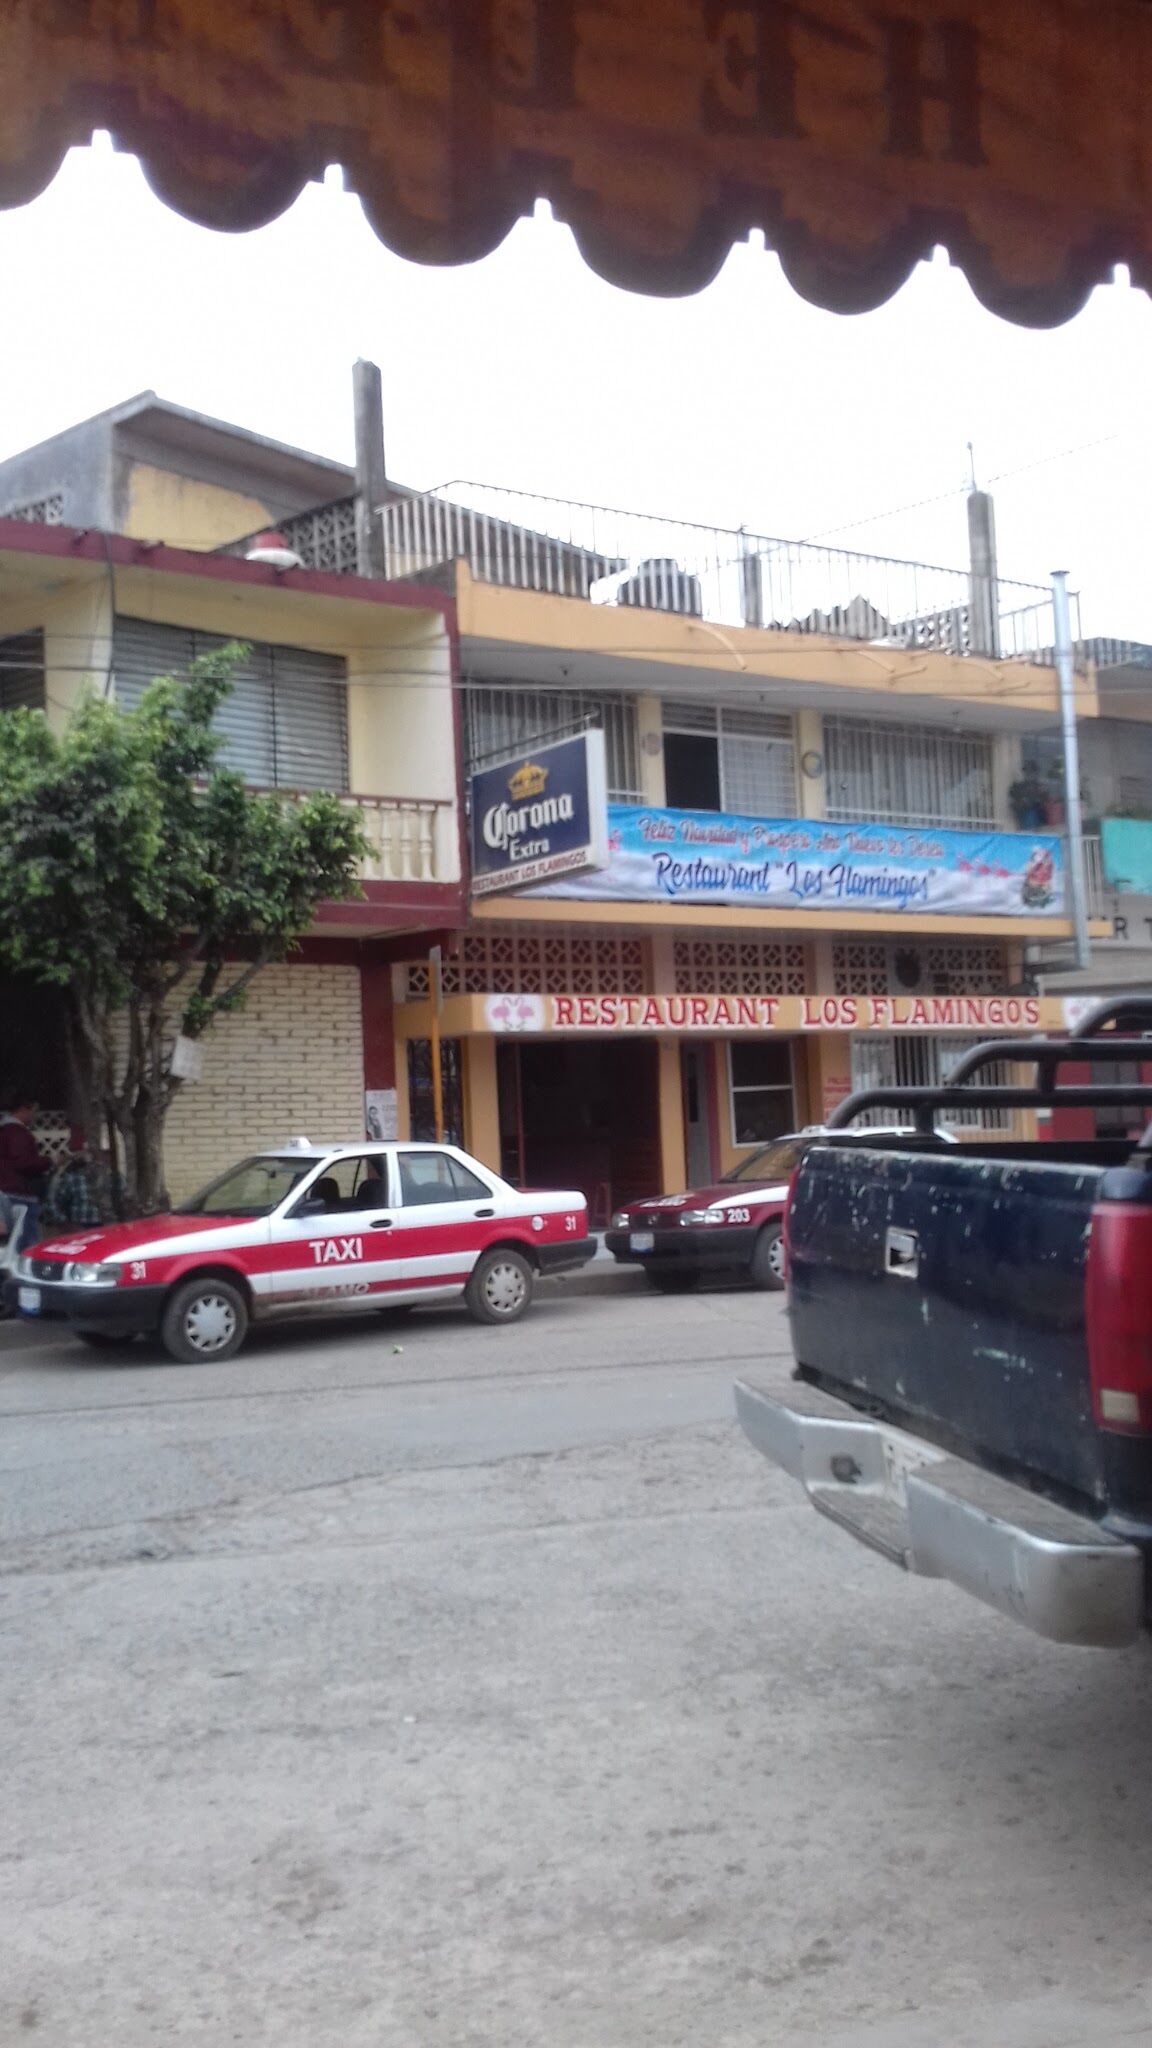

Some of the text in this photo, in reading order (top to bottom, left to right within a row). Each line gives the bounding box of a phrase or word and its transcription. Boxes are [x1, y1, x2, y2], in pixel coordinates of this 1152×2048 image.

[483, 793, 574, 850] Corona
[509, 838, 550, 861] Extra
[521, 864, 537, 880] LOS
[652, 852, 771, 895] Restaurant
[553, 996, 1041, 1028] RESTAURANT LOS FLAMINGOS
[564, 1215, 576, 1232] 31
[727, 1208, 750, 1223] 203
[308, 1237, 363, 1264] TAXI
[130, 1260, 146, 1281] 31
